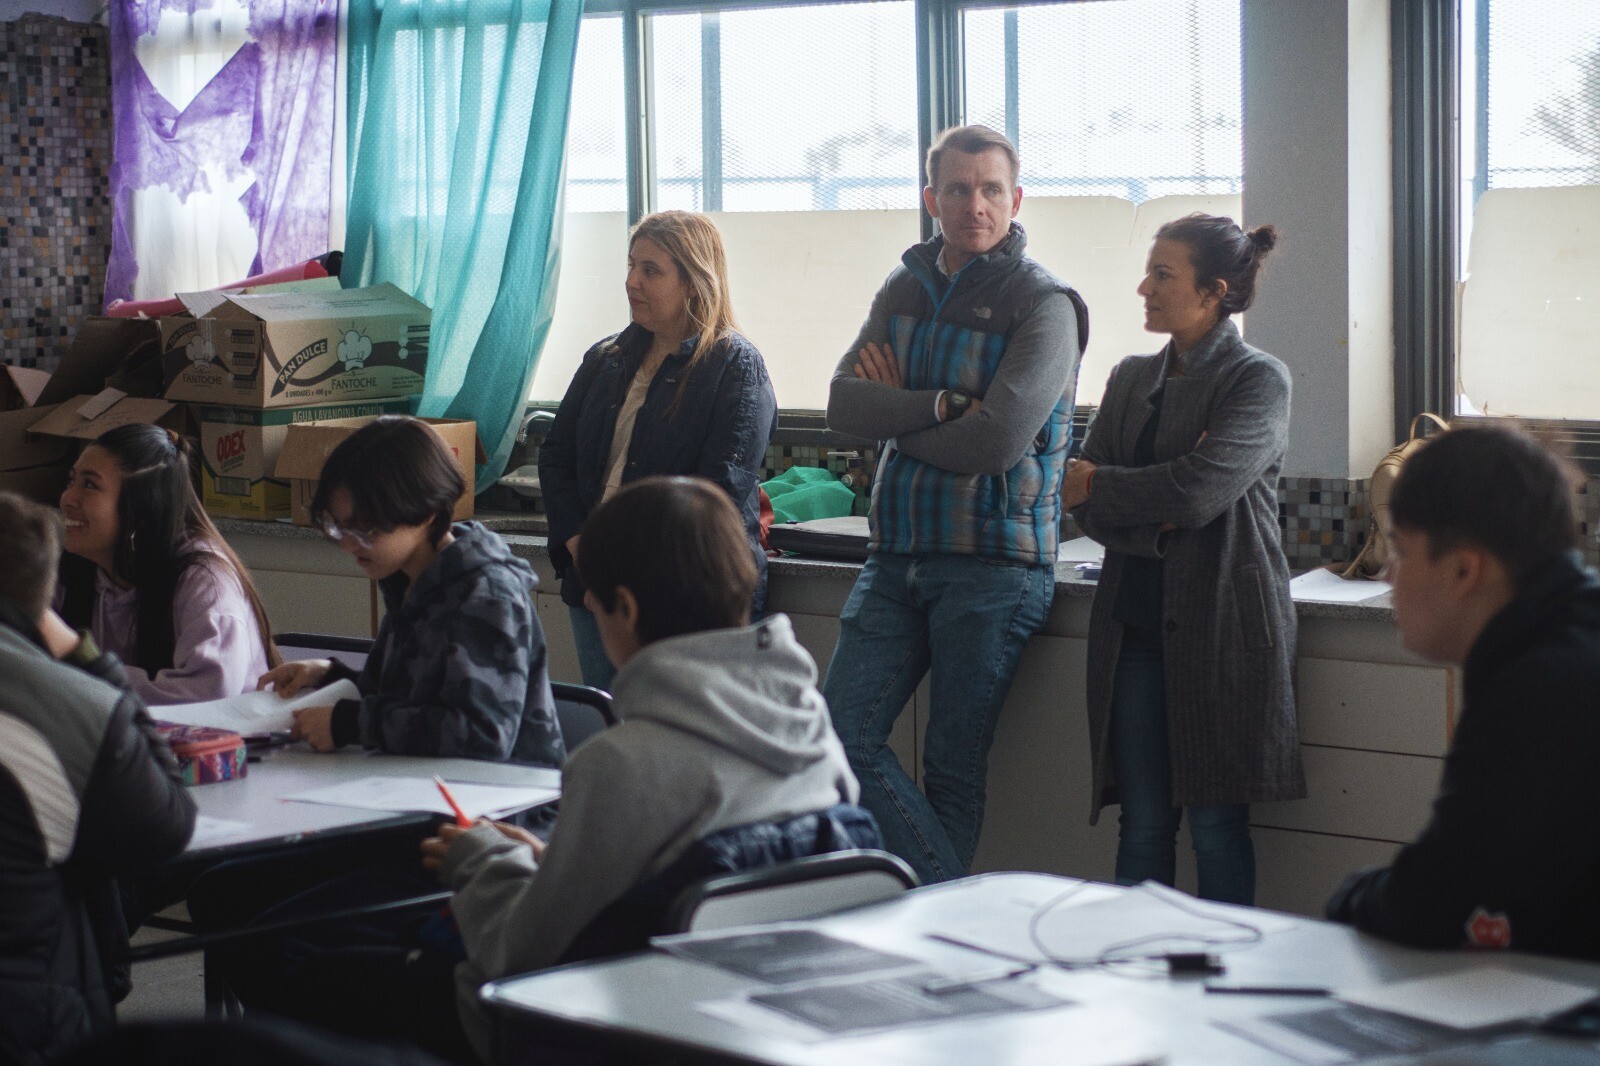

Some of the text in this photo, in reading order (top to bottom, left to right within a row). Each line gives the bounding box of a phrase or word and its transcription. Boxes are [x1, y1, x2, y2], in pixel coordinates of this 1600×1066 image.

[279, 361, 297, 385] PAN
[296, 341, 327, 365] DULCE
[182, 373, 223, 385] FANTOCHE
[332, 377, 378, 390] FANTOCHE
[292, 405, 385, 424] AGUA LAVANDINA COMÚN
[217, 429, 246, 462] ODEX
